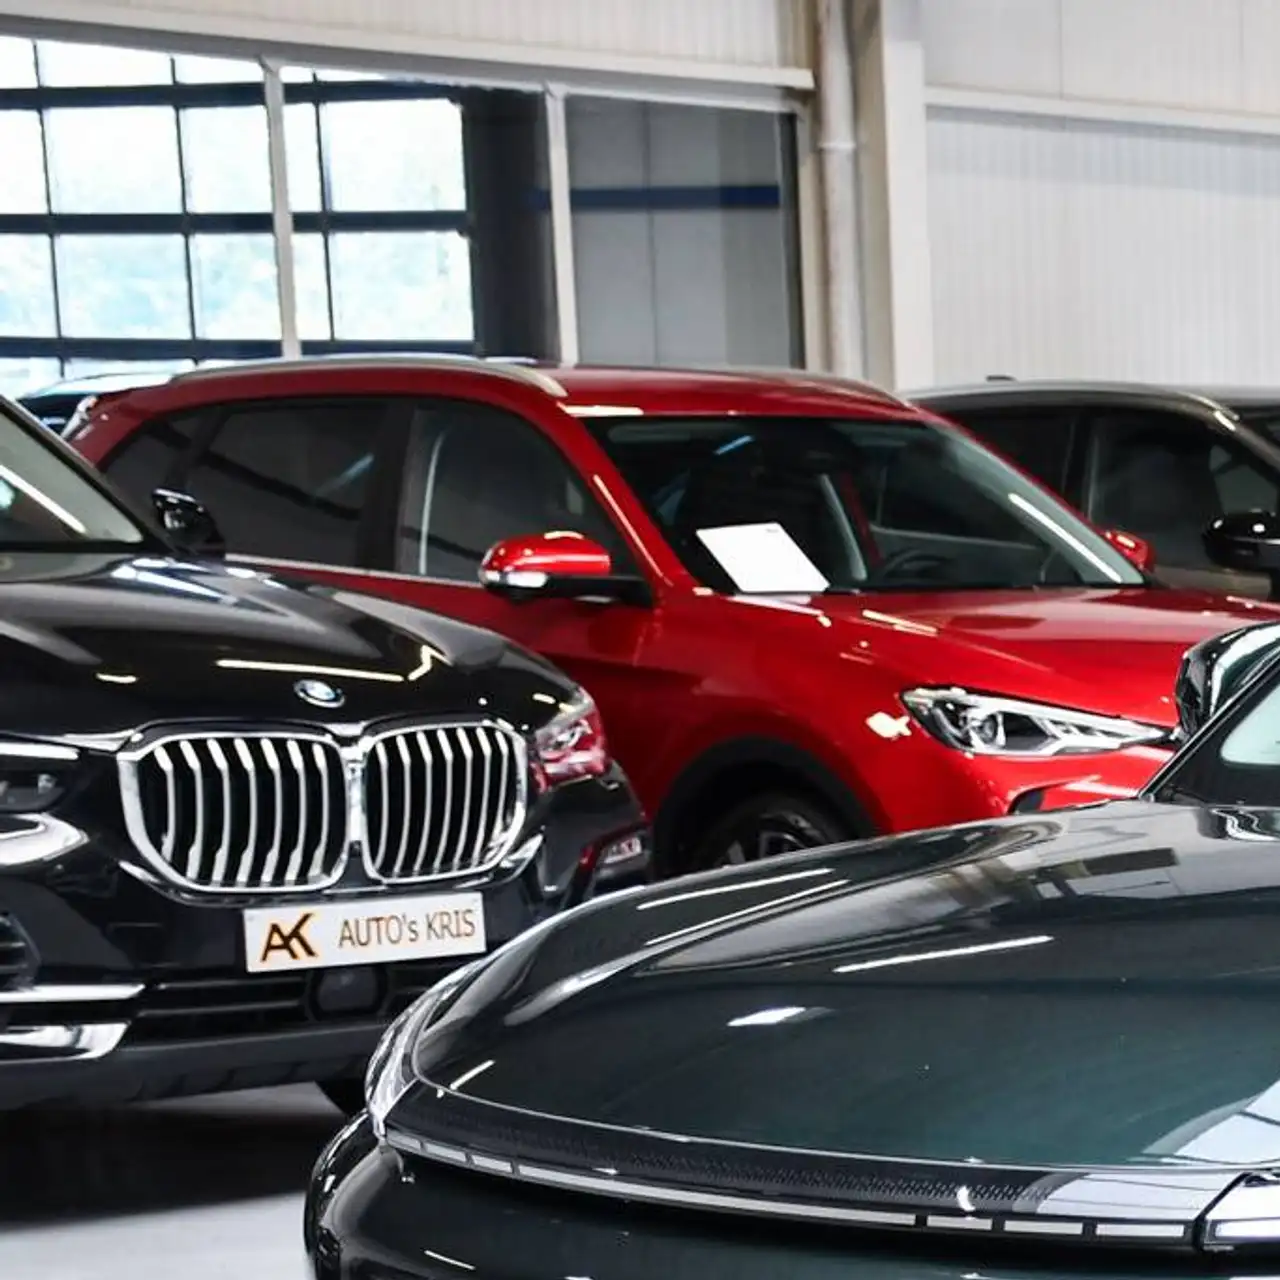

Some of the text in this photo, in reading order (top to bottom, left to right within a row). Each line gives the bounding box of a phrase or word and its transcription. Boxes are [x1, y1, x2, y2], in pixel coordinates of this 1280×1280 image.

[259, 909, 476, 963] AK AUTO's KRIS
